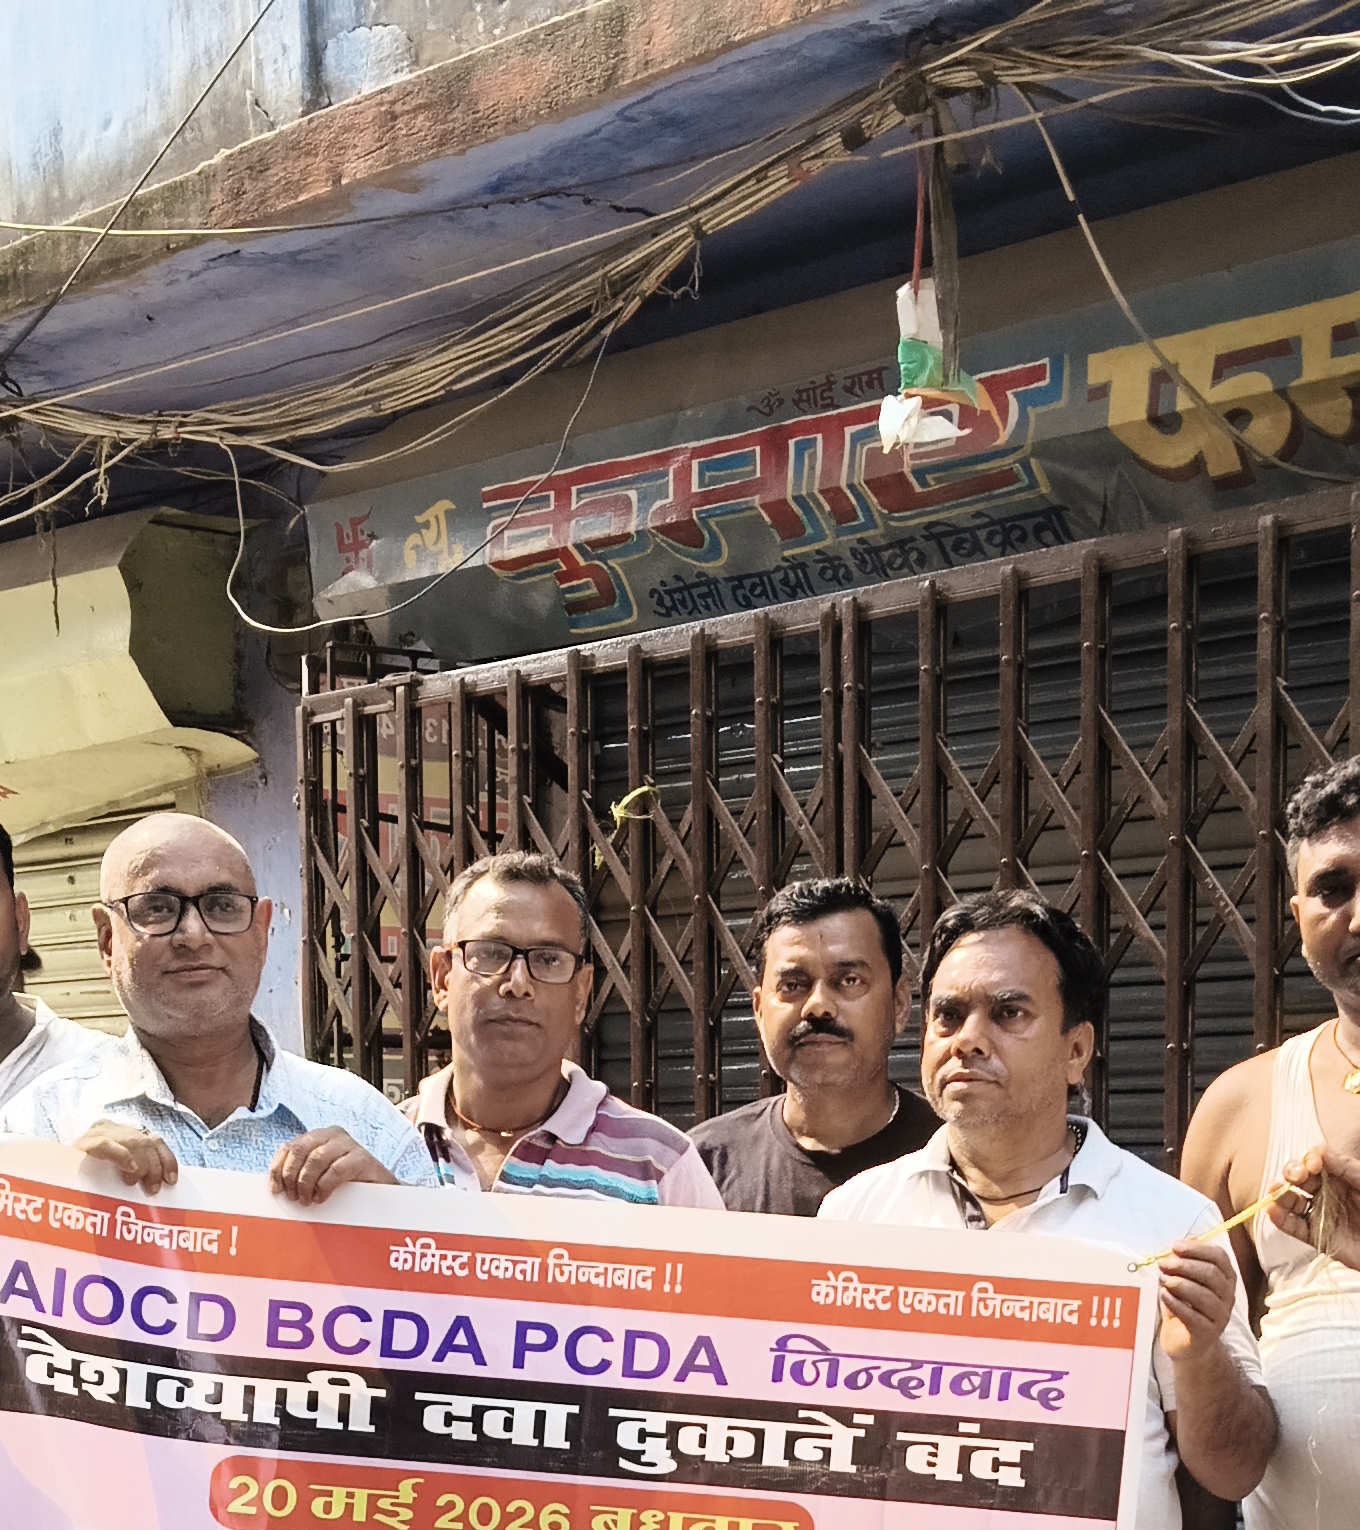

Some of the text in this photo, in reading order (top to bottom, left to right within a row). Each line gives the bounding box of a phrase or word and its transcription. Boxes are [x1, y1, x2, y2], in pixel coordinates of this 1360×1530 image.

[842, 366, 890, 398] राम
[481, 358, 1050, 625] कुमार
[849, 537, 930, 577] थोक
[49, 1203, 110, 1238] एकता
[115, 1210, 222, 1258] जिन्दाबाद
[389, 1237, 469, 1277] केमिस्ट
[475, 1251, 540, 1283] एकता
[547, 1248, 656, 1294] जिन्दाबाद
[811, 1271, 893, 1313] केमिस्ट
[898, 1284, 965, 1318] एकता
[971, 1282, 1083, 1327] जिन्दाबाद
[267, 1298, 488, 1369] BCDA
[512, 1319, 730, 1387] PCDA
[770, 1333, 1071, 1413] जिन्दाबाद
[17, 1326, 1035, 1489] देशव्यापी दवा दुकानें बंद
[228, 1475, 298, 1519] 20
